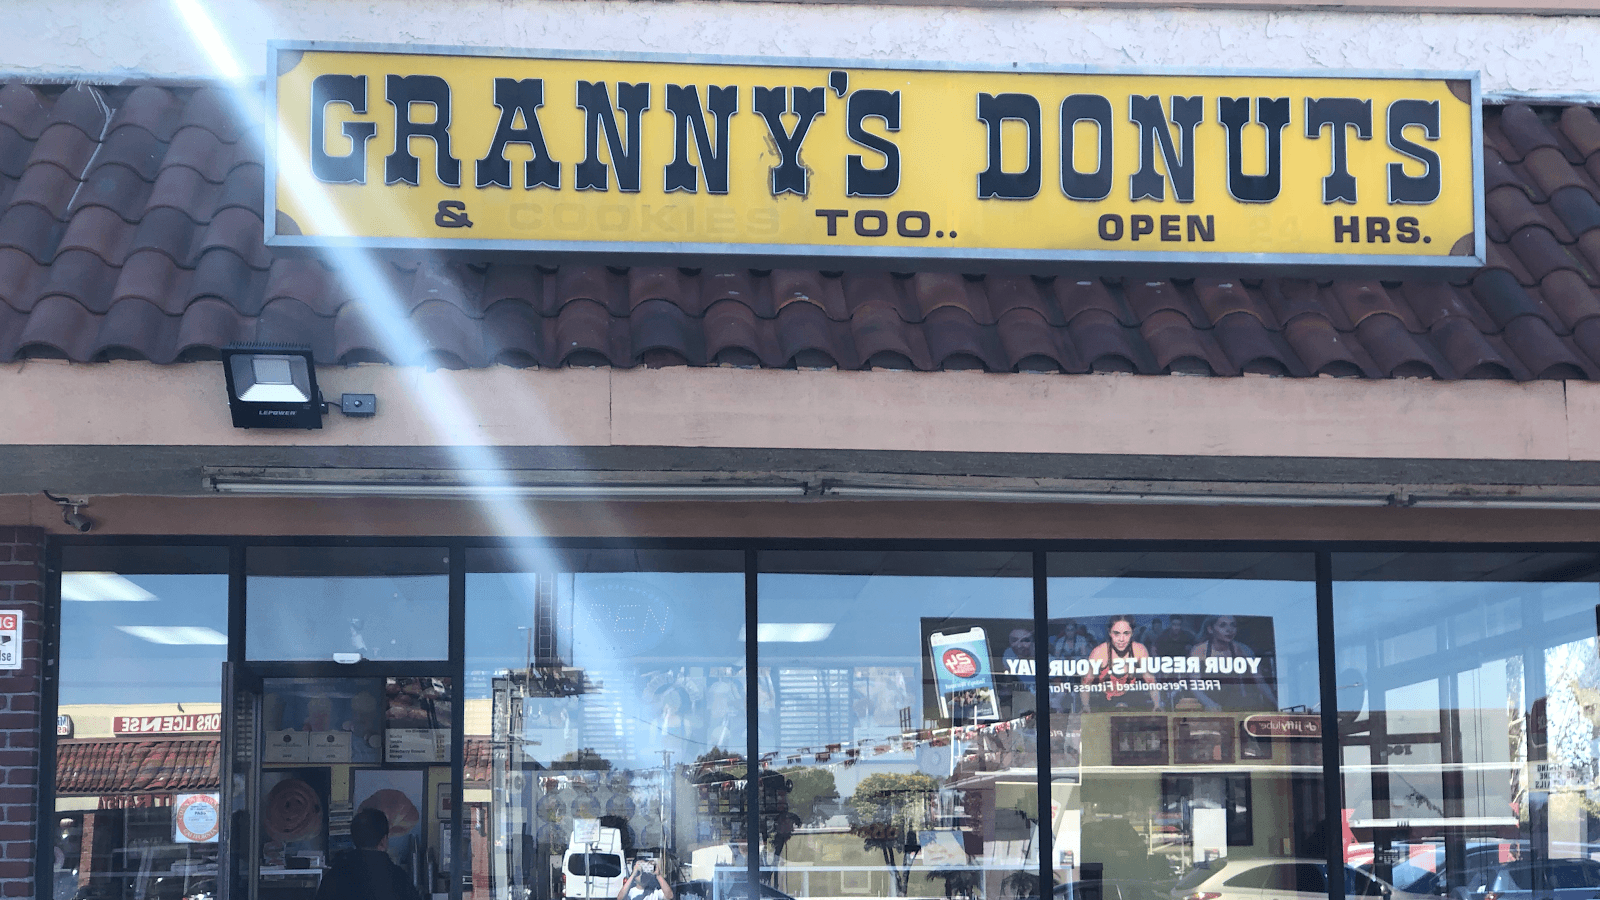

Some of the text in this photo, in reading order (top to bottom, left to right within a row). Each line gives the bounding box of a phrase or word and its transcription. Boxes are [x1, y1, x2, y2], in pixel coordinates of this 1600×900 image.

[311, 71, 1443, 204] GRANNY'S DONUTS
[435, 200, 474, 228] &
[1098, 212, 1217, 242] OPEN
[1334, 216, 1433, 245] HRS.
